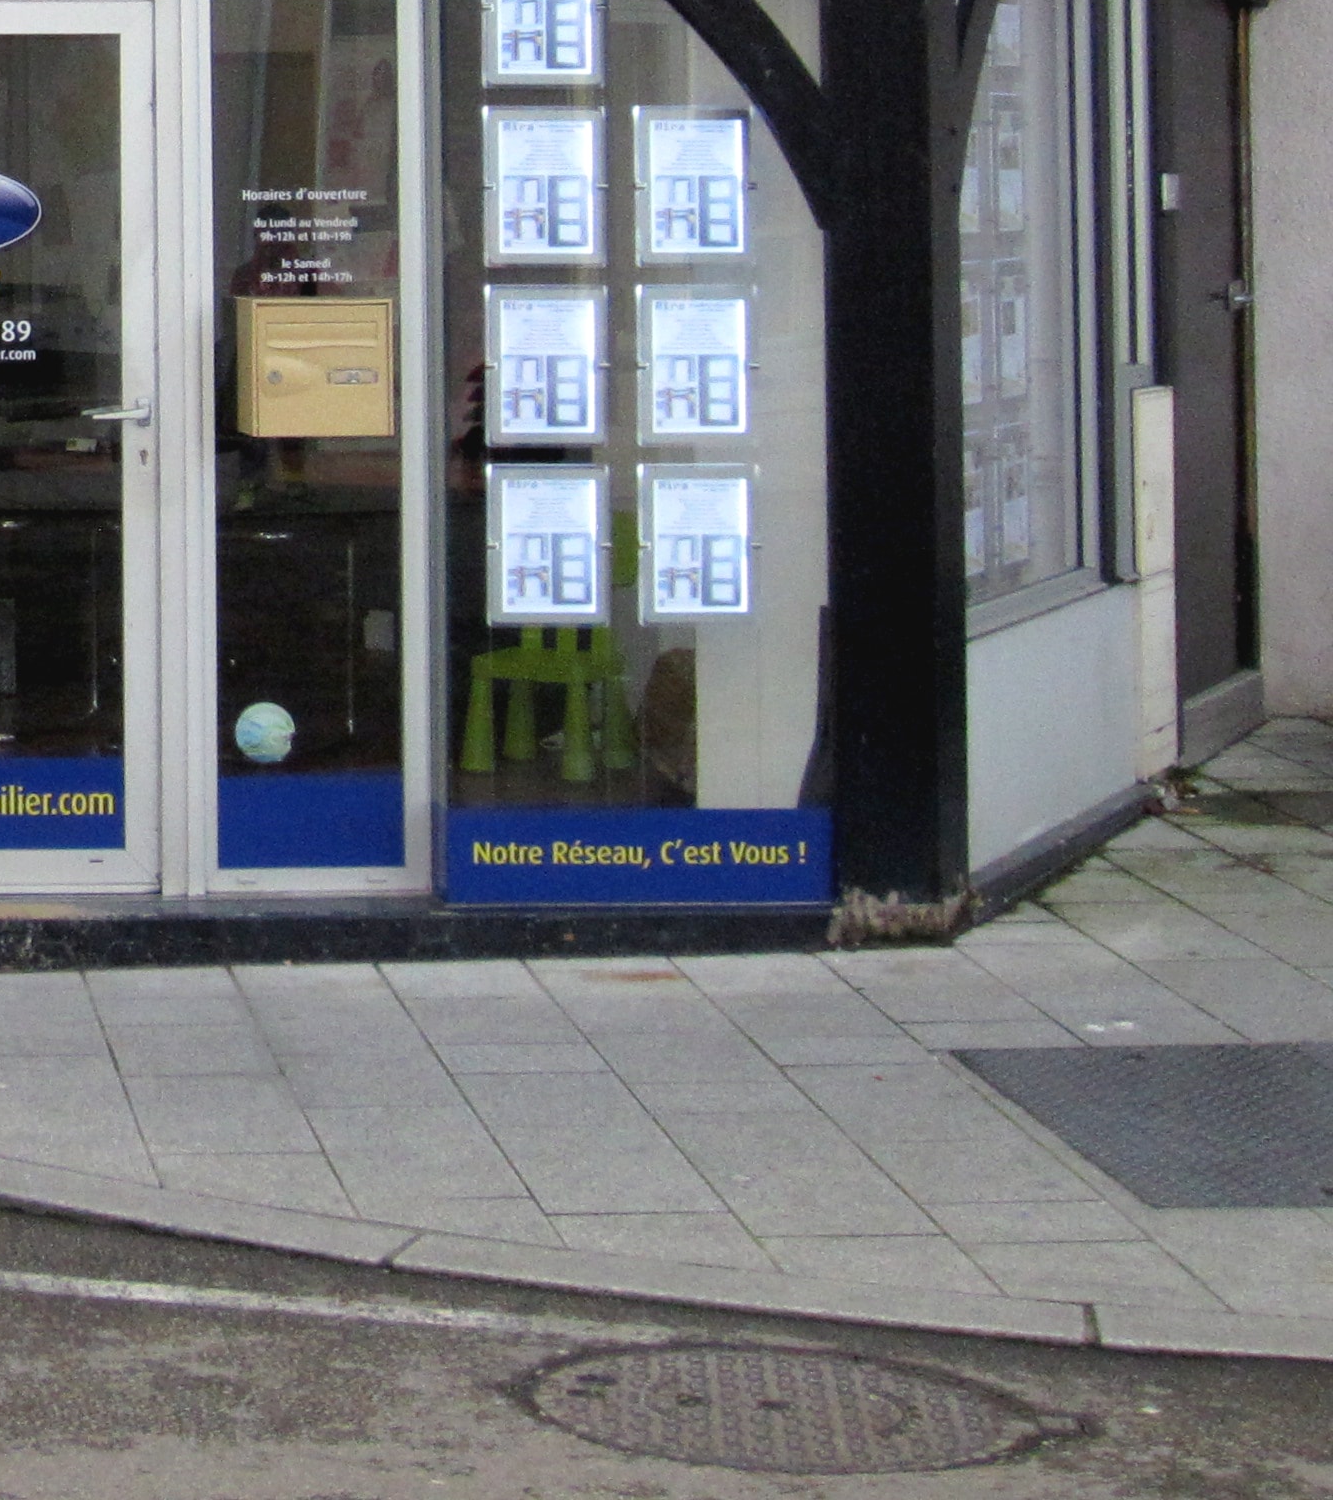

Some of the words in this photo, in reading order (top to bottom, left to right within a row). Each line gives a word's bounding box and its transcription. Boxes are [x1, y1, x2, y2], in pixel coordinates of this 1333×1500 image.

[241, 189, 292, 201] Horaires
[295, 187, 368, 201] d'ouverture
[253, 218, 267, 229] du
[269, 217, 297, 228] Lundi
[298, 219, 312, 228] au
[313, 216, 359, 228] Vendredi
[259, 231, 296, 242] 9h-12h
[298, 232, 308, 242] et
[281, 258, 292, 269] le
[294, 257, 331, 269] Samedi
[260, 271, 296, 283] 9h-12h
[298, 272, 309, 283] et
[0, 319, 32, 343] 89
[472, 841, 543, 865] Notre
[551, 840, 652, 869] Réseau,
[660, 839, 723, 865] C'est
[729, 841, 790, 865] Vous
